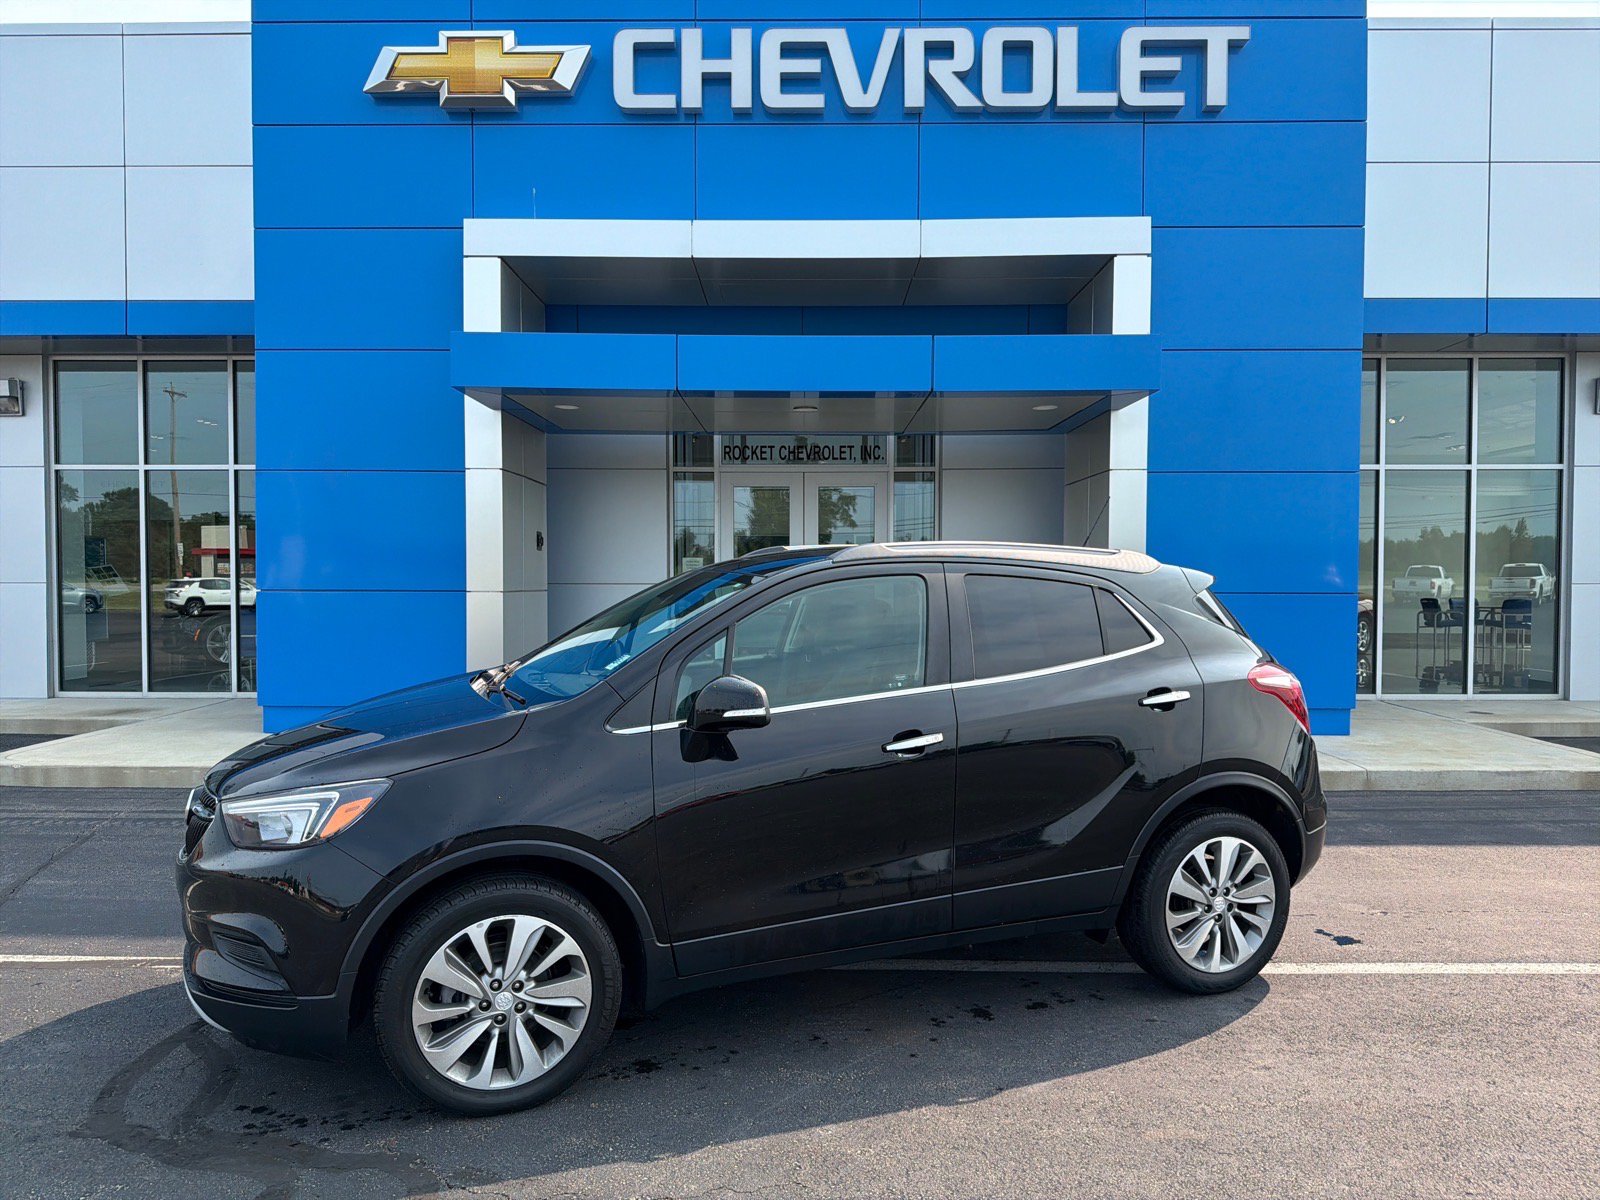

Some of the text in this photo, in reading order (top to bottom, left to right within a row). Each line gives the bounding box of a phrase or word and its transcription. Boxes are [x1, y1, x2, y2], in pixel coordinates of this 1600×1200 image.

[613, 25, 1251, 112] CHEVROLET
[723, 445, 884, 463] ROCKET CHEVROLET, INC.
